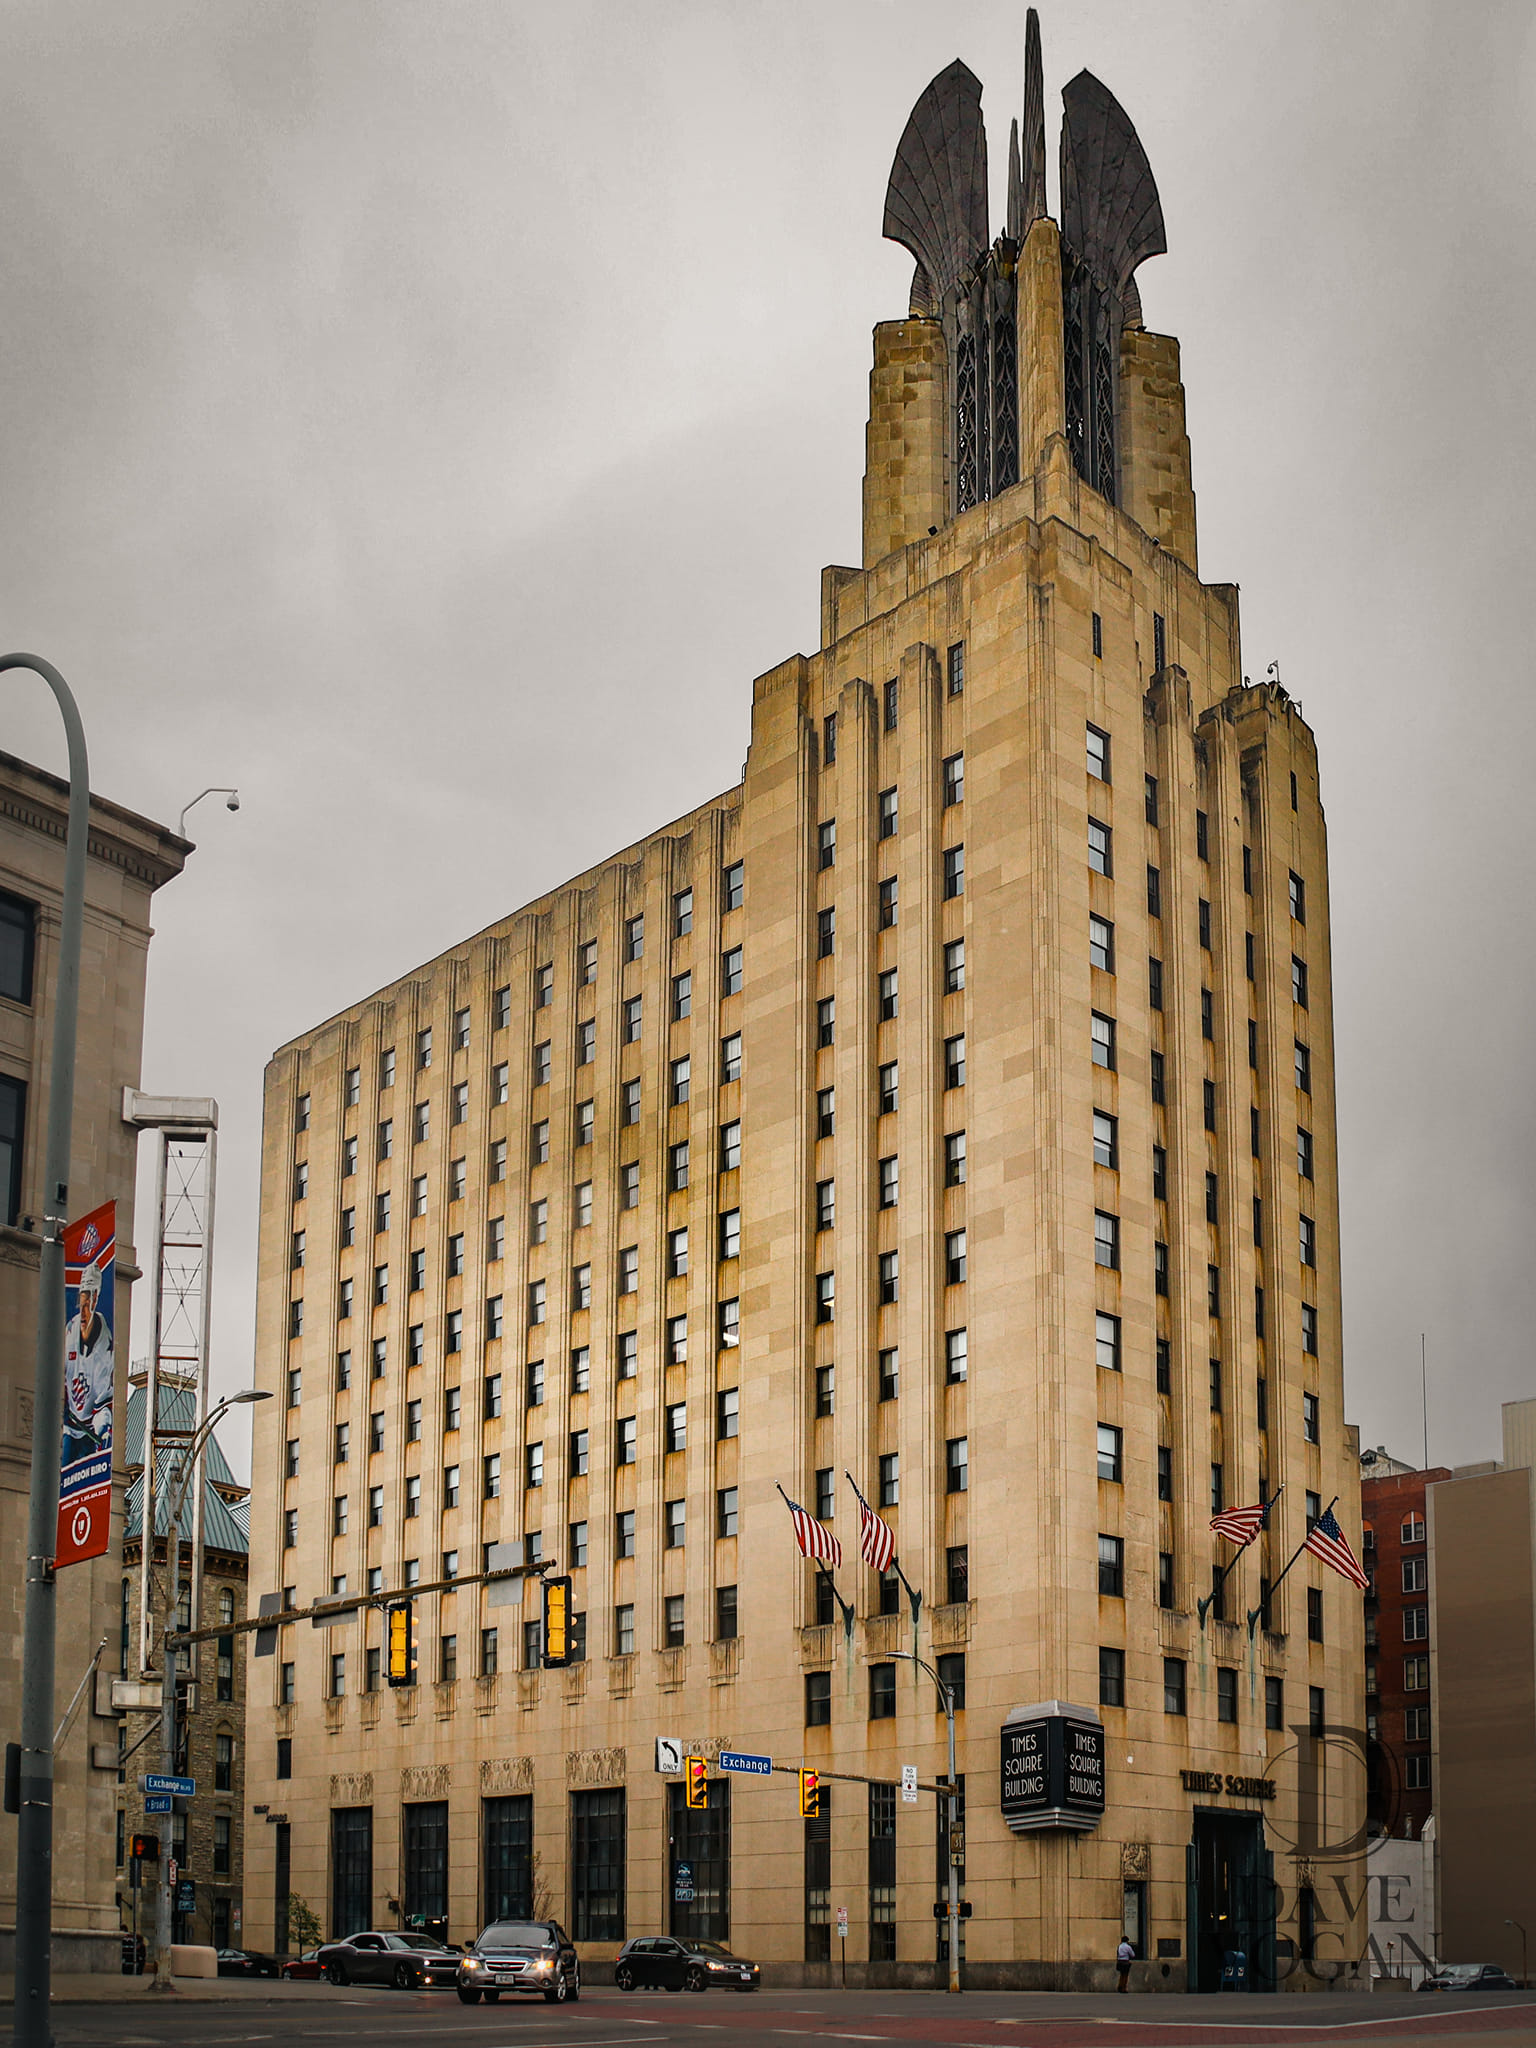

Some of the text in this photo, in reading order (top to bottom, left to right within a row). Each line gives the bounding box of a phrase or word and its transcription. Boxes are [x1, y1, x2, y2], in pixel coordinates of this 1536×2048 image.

[1011, 1733, 1037, 1754] TIMES
[1074, 1733, 1097, 1753] TIMES
[662, 1763, 679, 1771] ONLY
[722, 1755, 769, 1774] Exchange
[1005, 1754, 1044, 1776] SQUARE
[1069, 1753, 1102, 1776] SQUARE
[148, 1777, 180, 1792] Exchange
[1005, 1776, 1044, 1798] BUILDING
[1069, 1775, 1103, 1797] BUILDING
[1179, 1769, 1277, 1801] TIMES SQUARE
